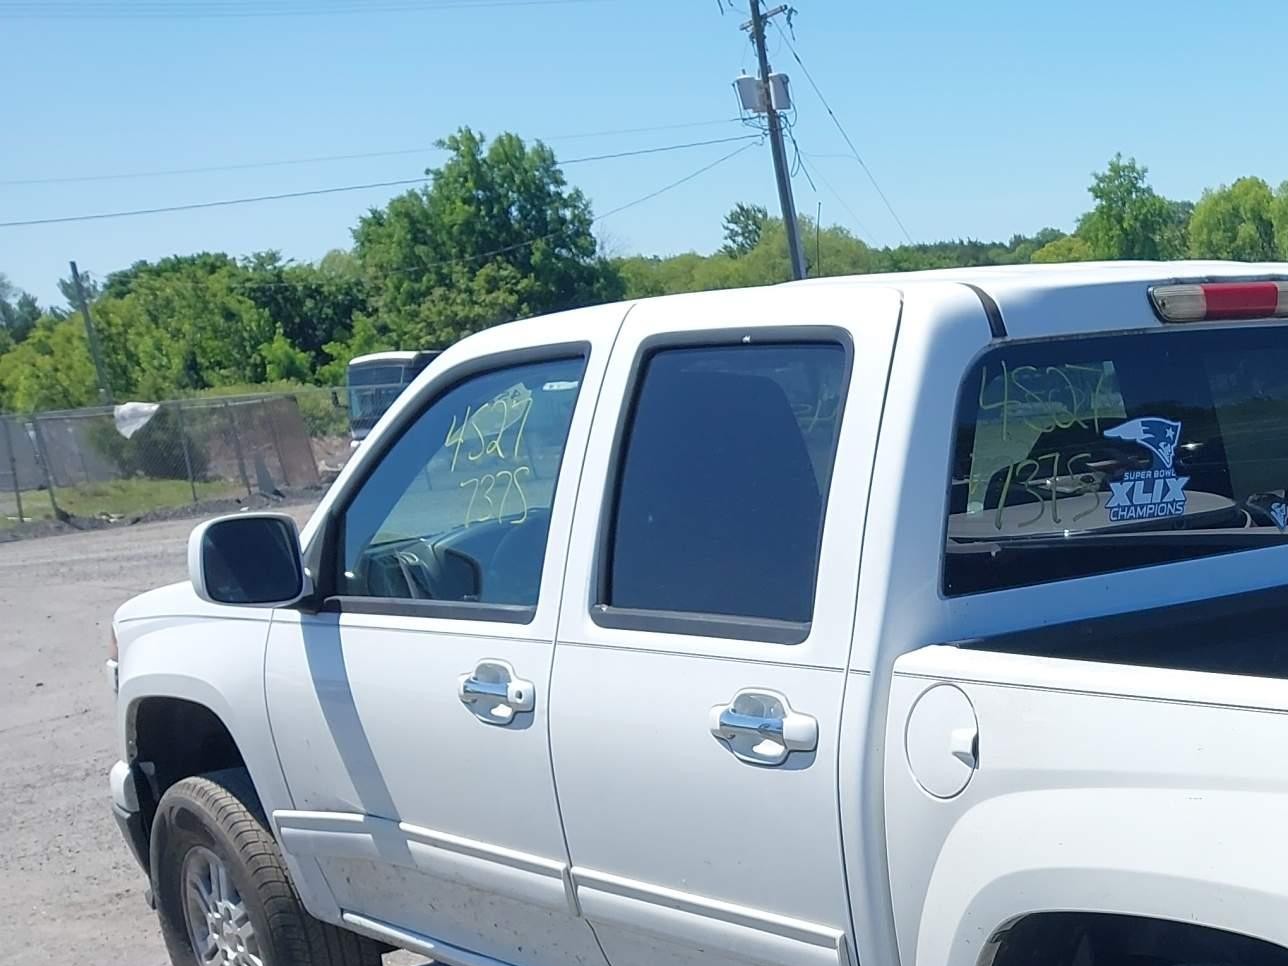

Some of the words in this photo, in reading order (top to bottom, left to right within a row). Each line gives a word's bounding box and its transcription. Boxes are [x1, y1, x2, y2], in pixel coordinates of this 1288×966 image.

[978, 359, 1104, 440] 4527
[444, 396, 533, 473] 4527
[459, 466, 529, 528] 7375
[1105, 476, 1190, 508] XLIX
[1123, 469, 1152, 480] SUPER
[1153, 469, 1176, 478] BOWL
[1109, 501, 1184, 521] CHAMPIONS
